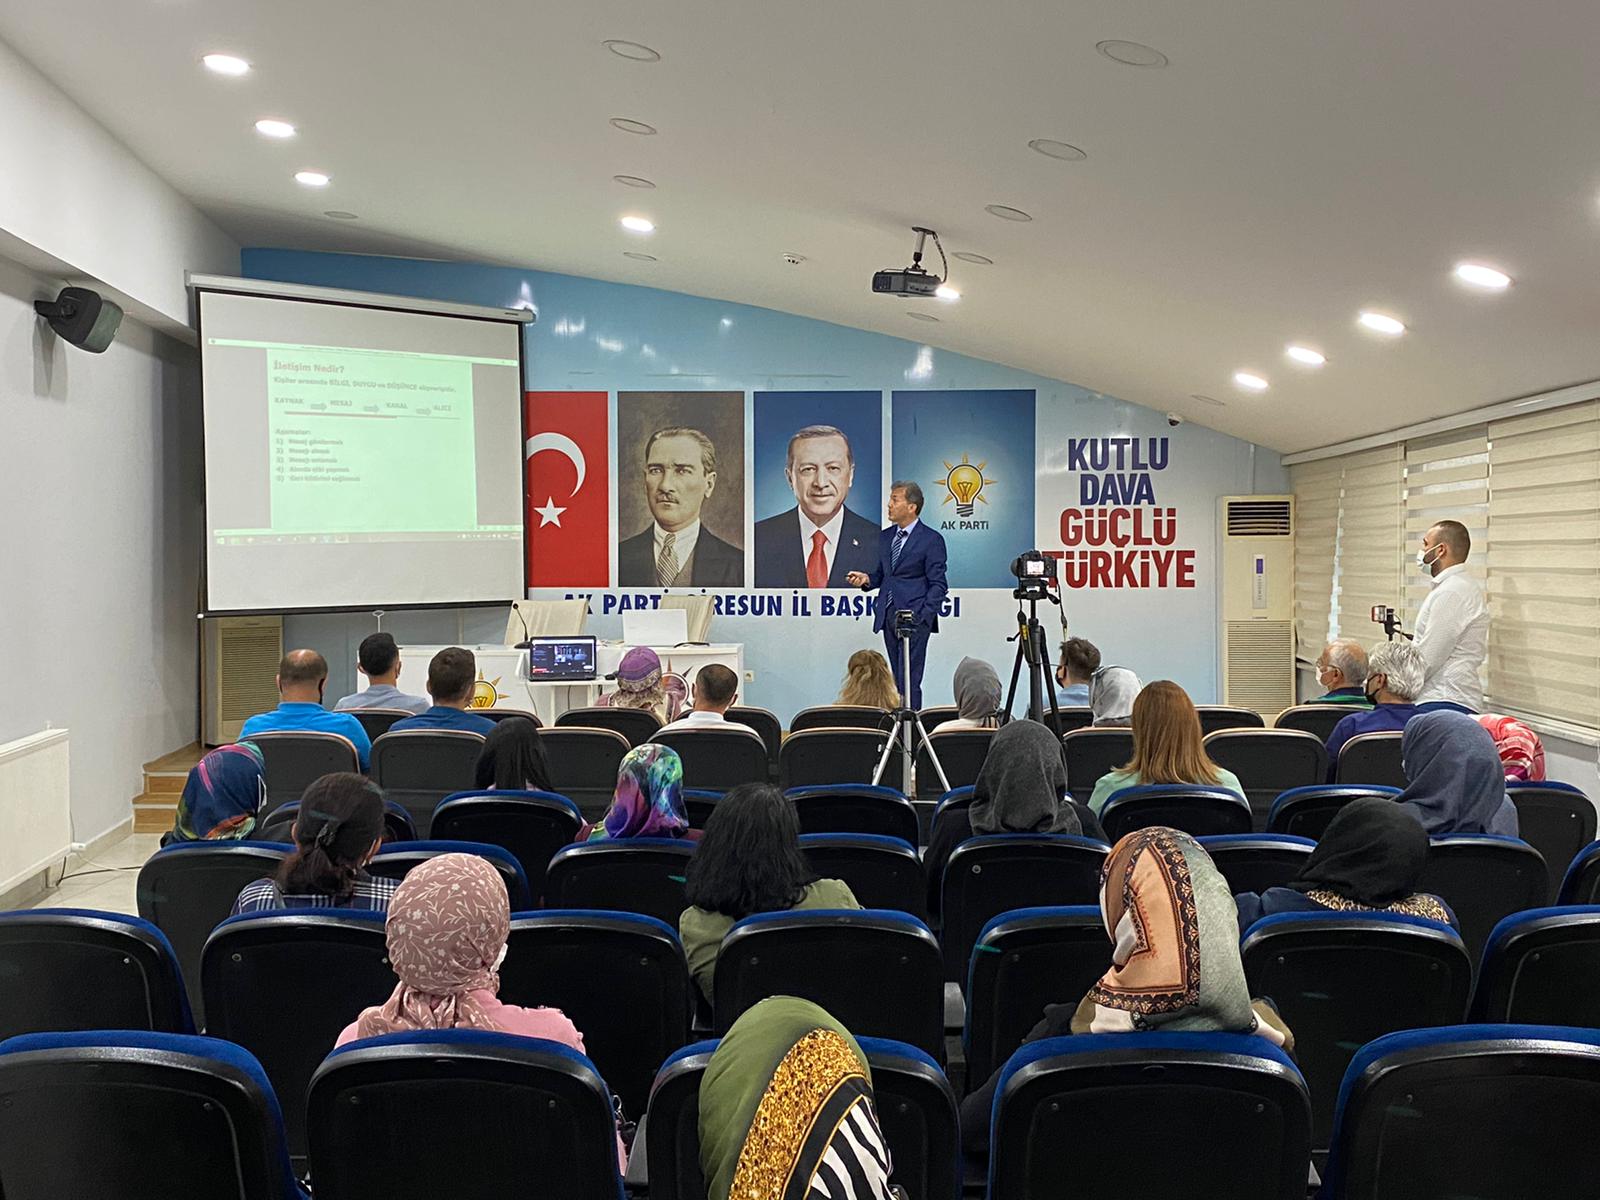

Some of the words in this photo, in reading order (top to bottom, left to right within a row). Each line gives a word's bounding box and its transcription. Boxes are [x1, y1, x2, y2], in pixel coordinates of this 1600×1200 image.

[273, 360, 311, 372] İletişim
[314, 364, 345, 374] Nedir?
[1068, 438, 1169, 471] KUTLU
[1080, 473, 1156, 505] DAVA
[941, 521, 956, 530] AK
[960, 521, 989, 530] PARTİ
[1060, 508, 1176, 548] GÜÇLÜ
[603, 588, 669, 615] PART
[793, 590, 811, 616] İL
